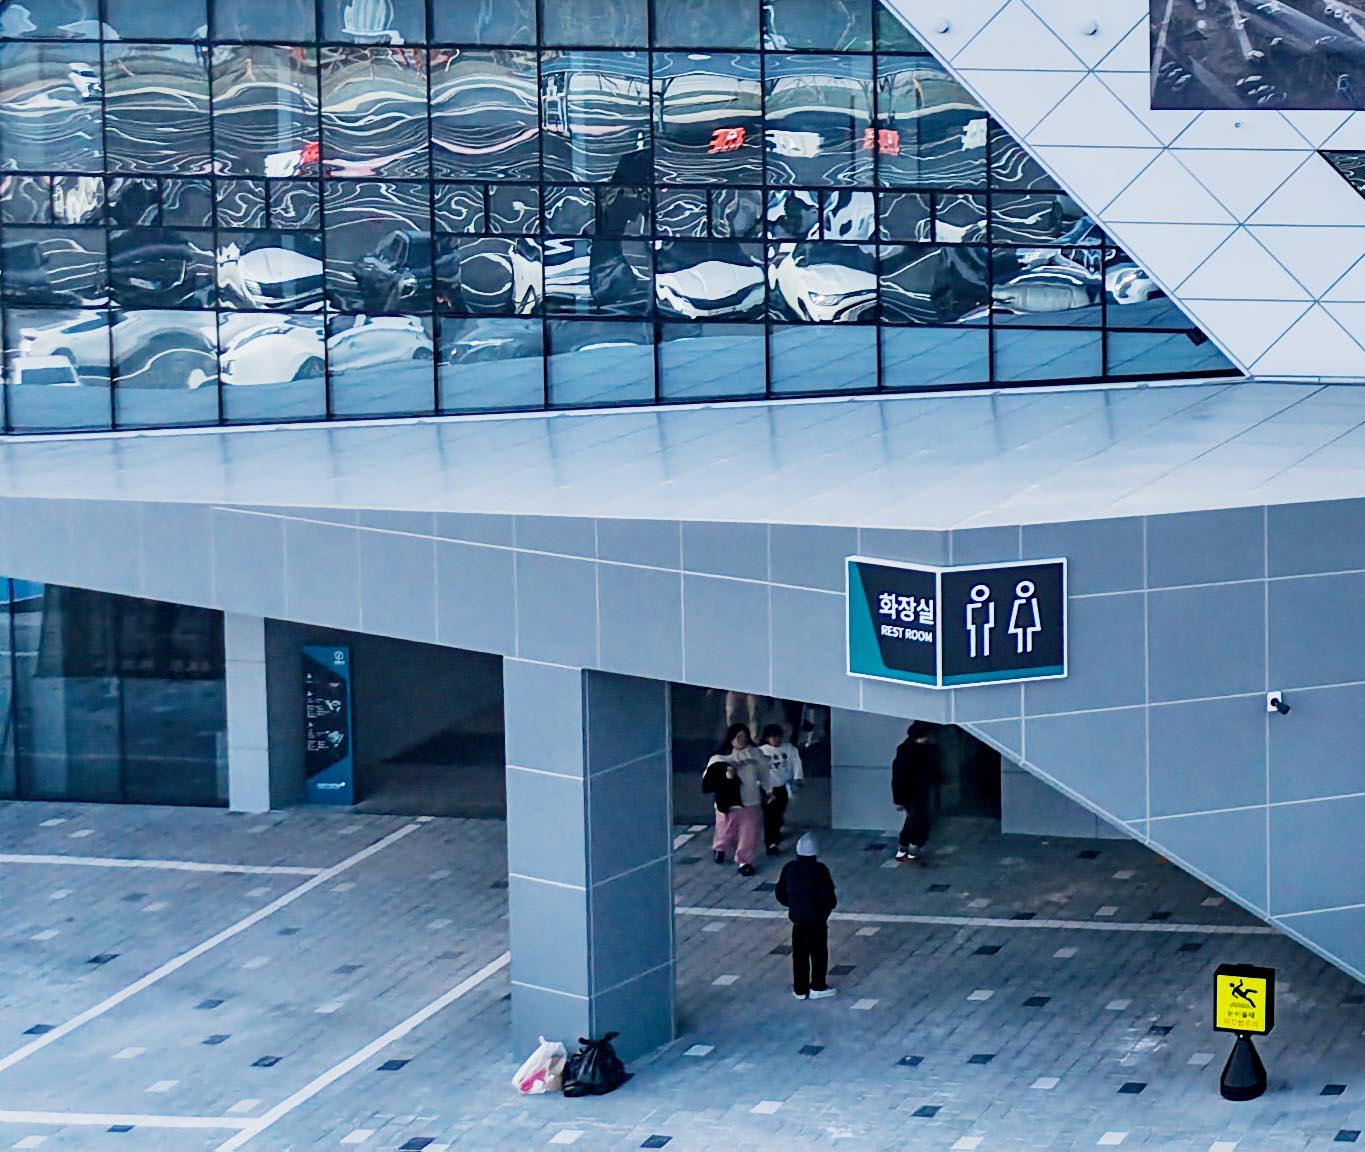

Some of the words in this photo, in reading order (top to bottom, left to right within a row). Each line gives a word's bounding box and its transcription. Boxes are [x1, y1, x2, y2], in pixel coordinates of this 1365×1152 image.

[878, 592, 935, 625] 화장실
[880, 624, 905, 639] REST
[904, 628, 933, 643] ROOM
